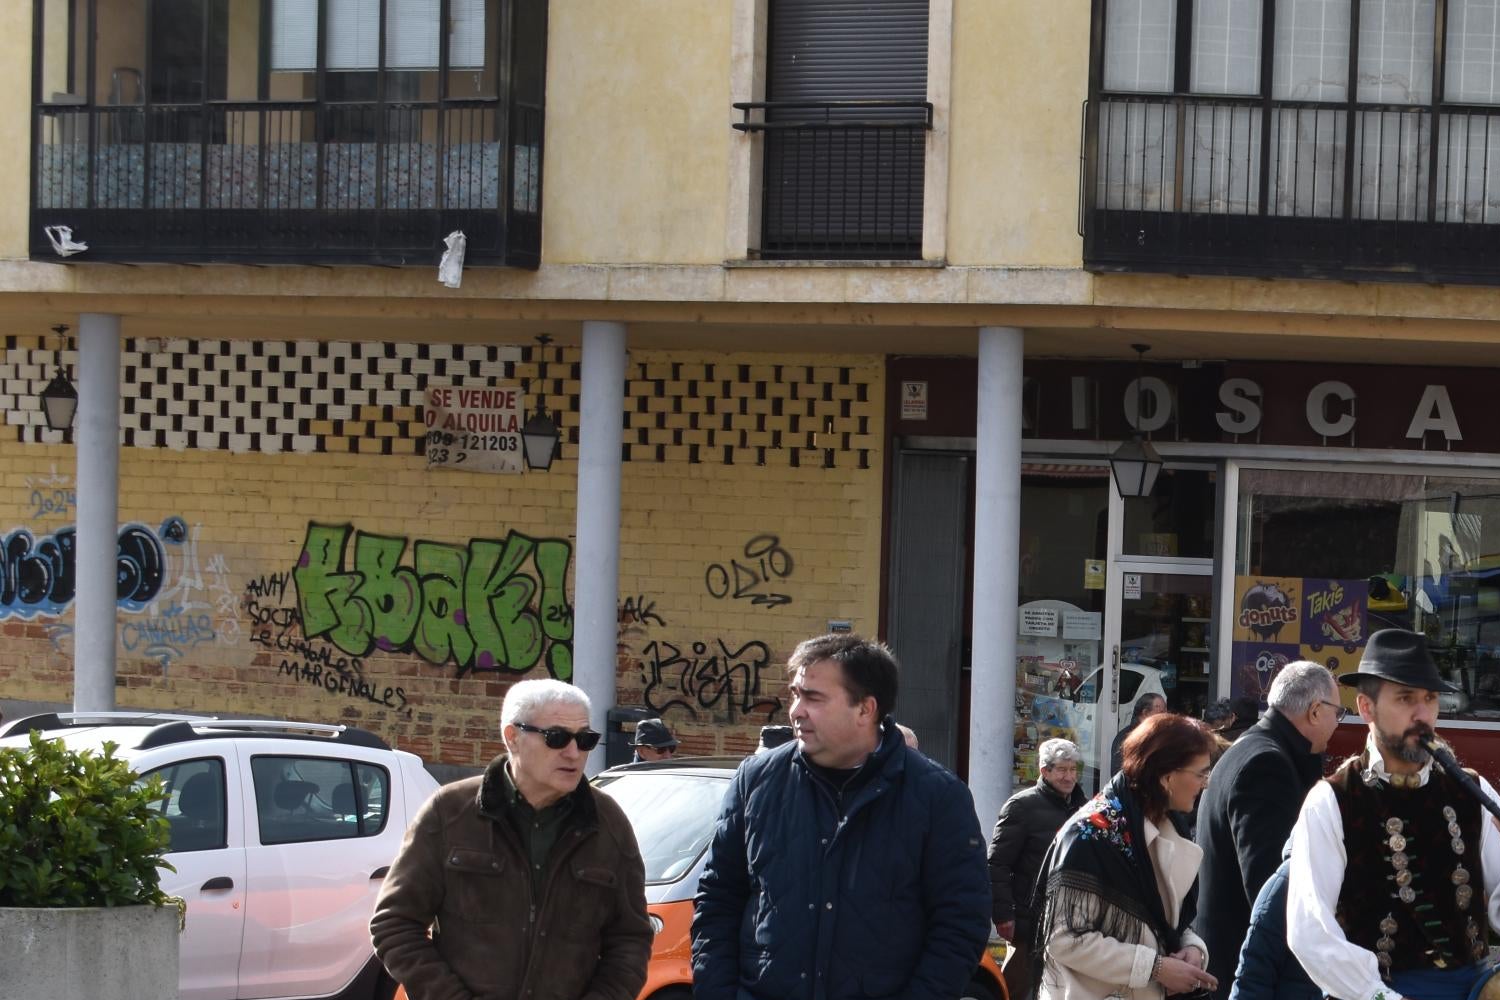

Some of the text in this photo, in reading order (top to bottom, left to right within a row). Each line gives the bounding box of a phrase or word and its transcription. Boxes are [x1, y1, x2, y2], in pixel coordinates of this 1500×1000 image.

[431, 389, 516, 410] SE VENDE
[425, 410, 519, 433] O ALQUILA
[461, 434, 517, 451] 121203
[1307, 585, 1344, 619] Takis
[1239, 606, 1297, 628] donuts
